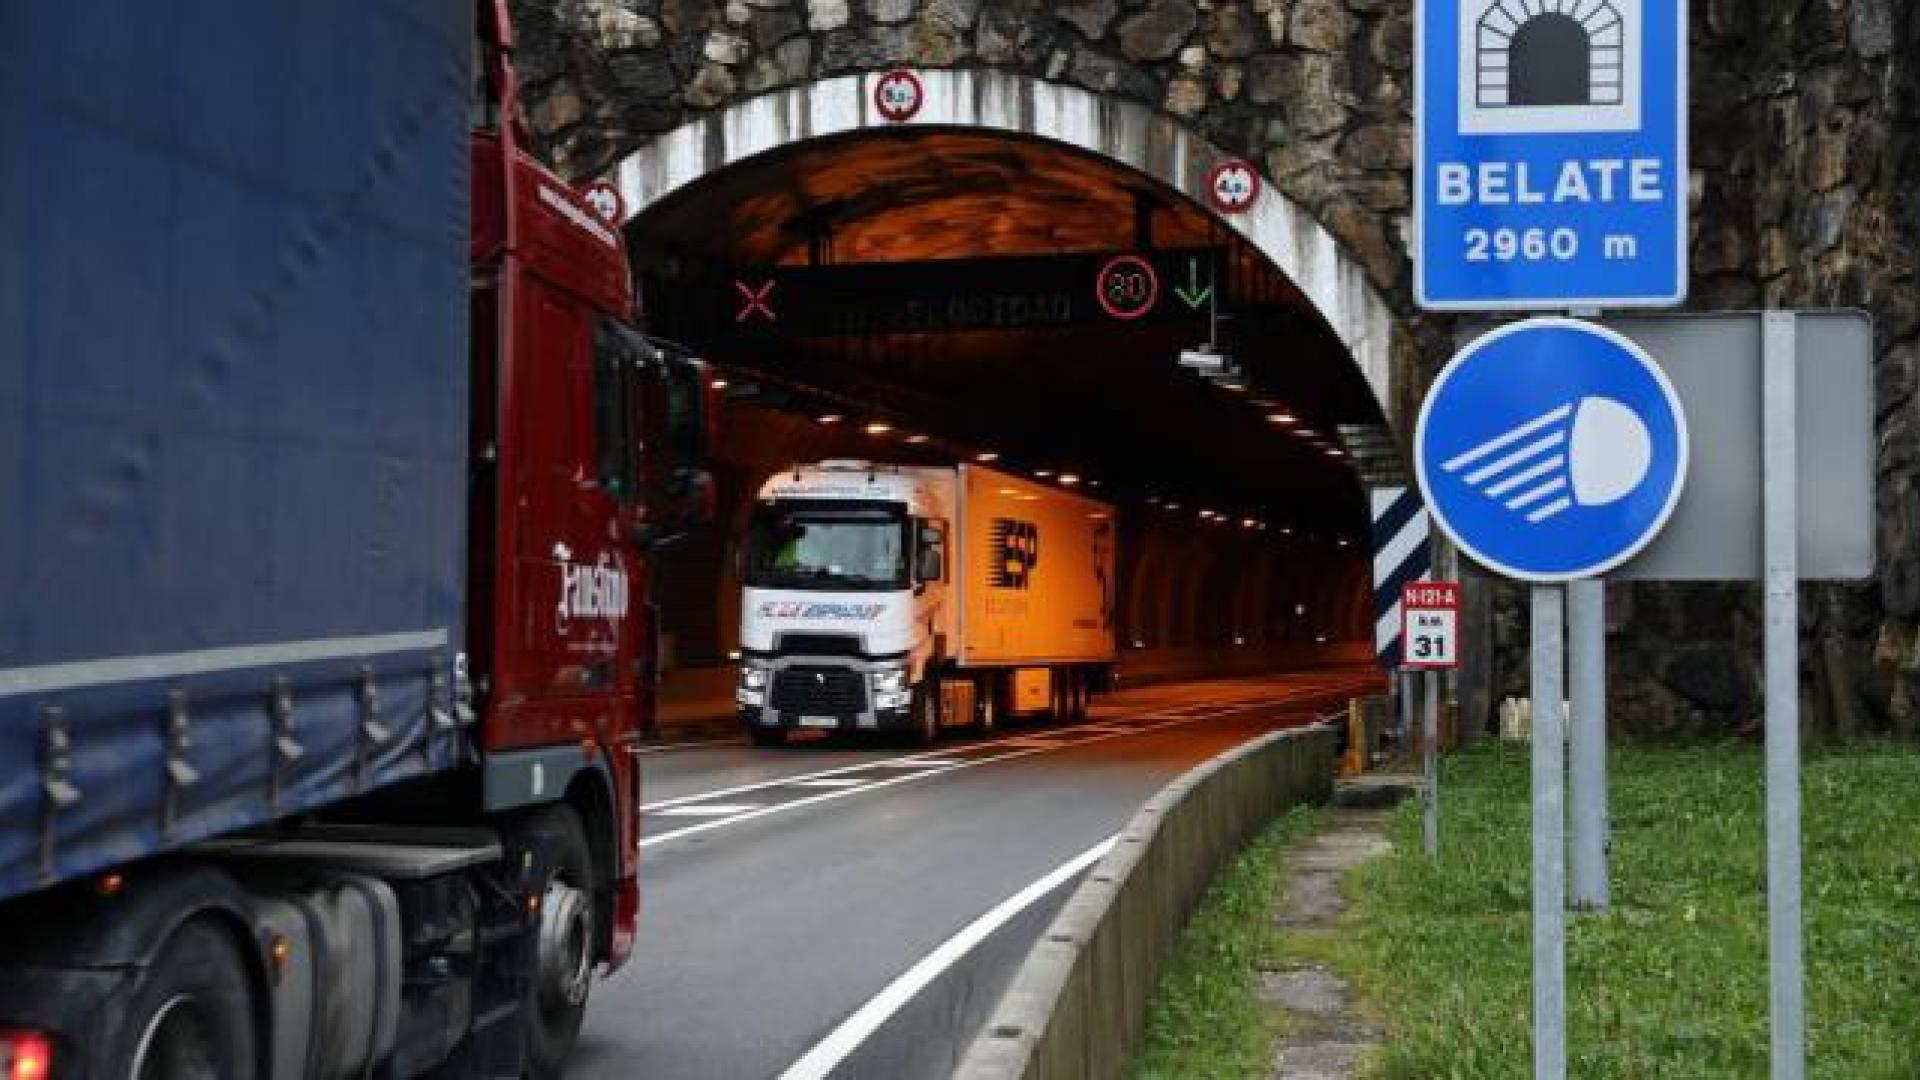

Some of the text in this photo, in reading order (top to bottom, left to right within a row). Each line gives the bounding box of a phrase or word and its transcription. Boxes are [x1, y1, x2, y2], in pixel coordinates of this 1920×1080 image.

[1437, 158, 1663, 204] BELATE
[1464, 227, 1636, 261] 2960 m
[1108, 273, 1146, 303] 80
[1415, 635, 1445, 656] 31
